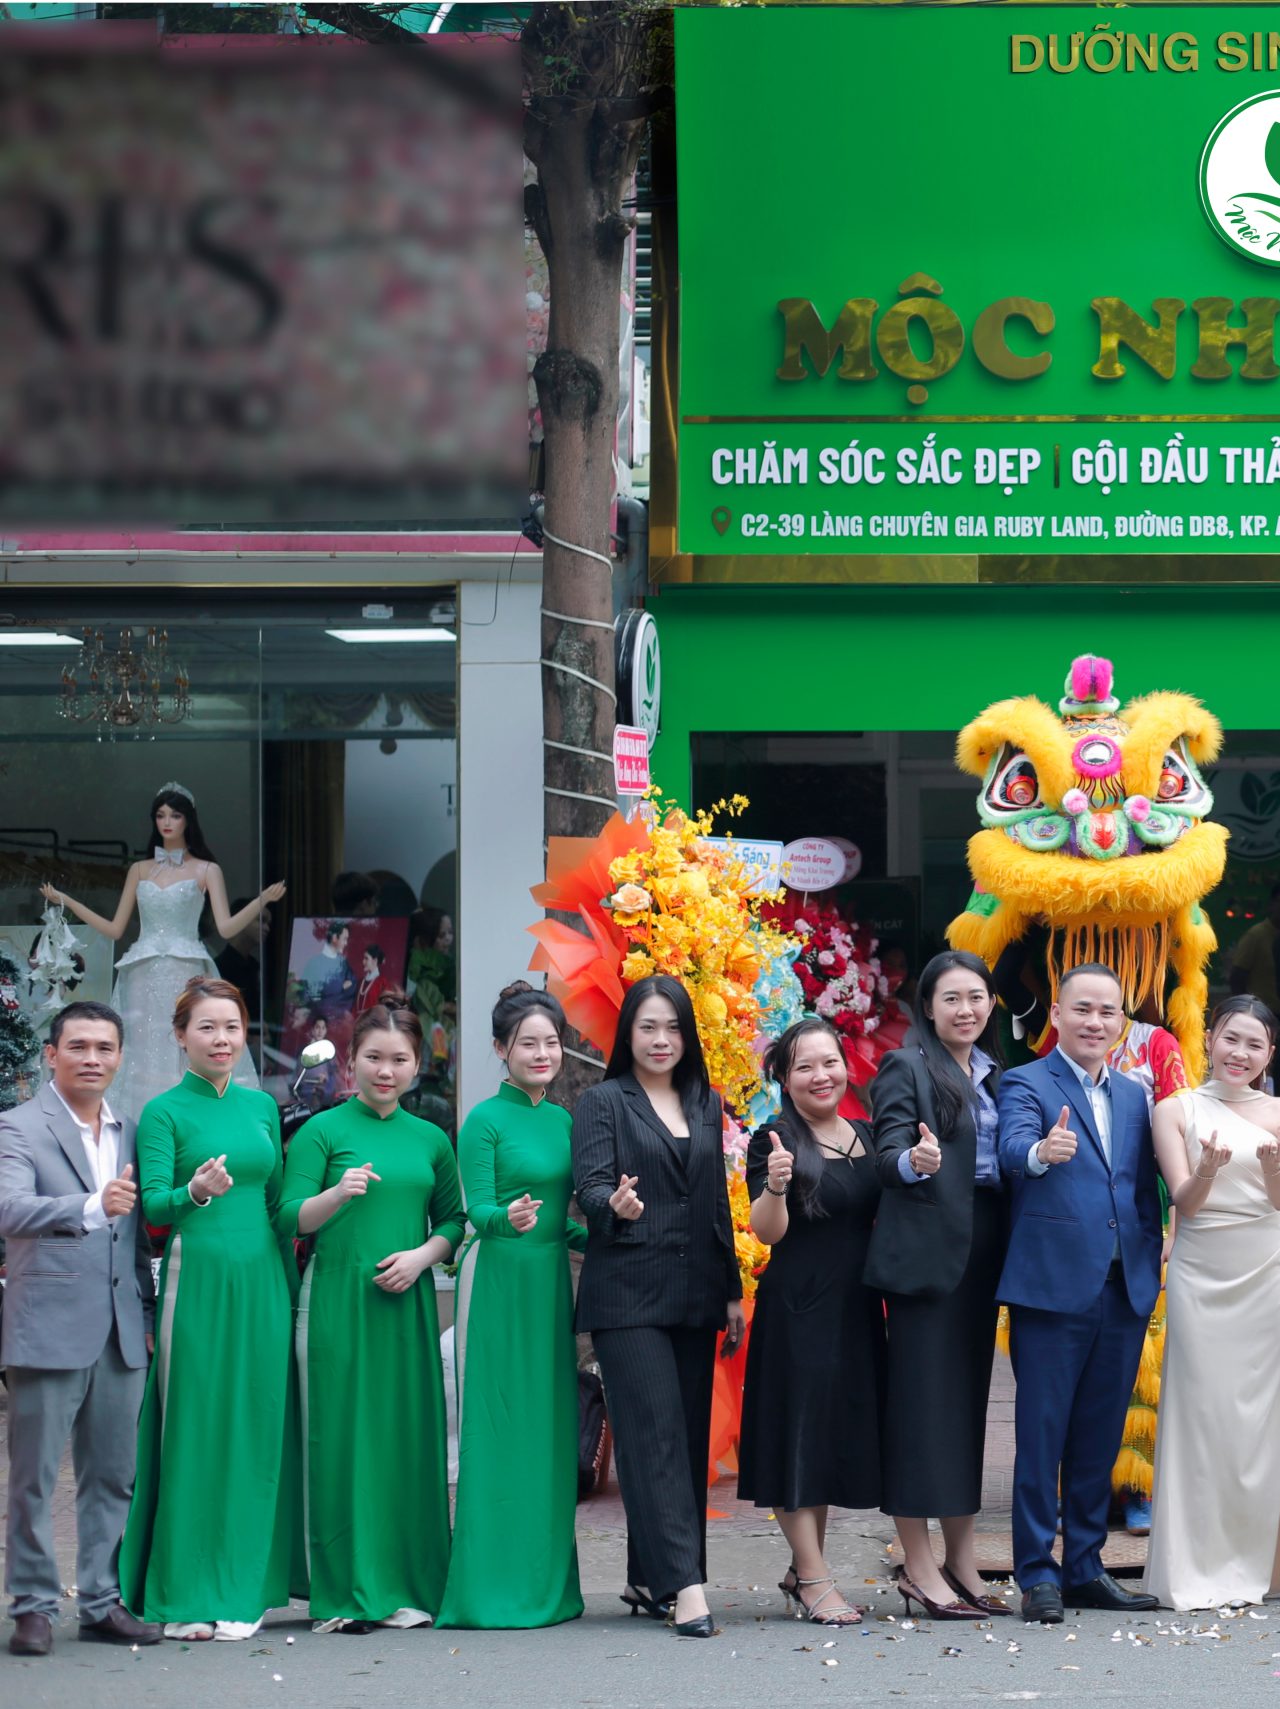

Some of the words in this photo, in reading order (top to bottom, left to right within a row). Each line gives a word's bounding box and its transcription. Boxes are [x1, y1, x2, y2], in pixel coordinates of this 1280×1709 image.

[1010, 22, 1199, 73] DƯỠNG
[1224, 203, 1263, 244] Mộc
[775, 272, 1056, 404] MỘC
[711, 440, 809, 485] CHĂM
[818, 439, 886, 485] SÓC
[896, 432, 963, 485] SẮC
[974, 447, 1042, 495] ĐẸP
[1071, 439, 1128, 495] GỘI
[1139, 432, 1209, 484] ĐẦU
[741, 513, 805, 537] C2-39
[810, 510, 864, 537] LÀNG
[869, 511, 949, 537] CHUYÊN
[954, 515, 989, 537] GIA
[994, 516, 1045, 537] RUBY
[1051, 516, 1109, 540] LAND,
[1114, 510, 1184, 537] ĐƯỜNG
[1189, 515, 1235, 539] DB8,
[1240, 516, 1270, 537] KP.
